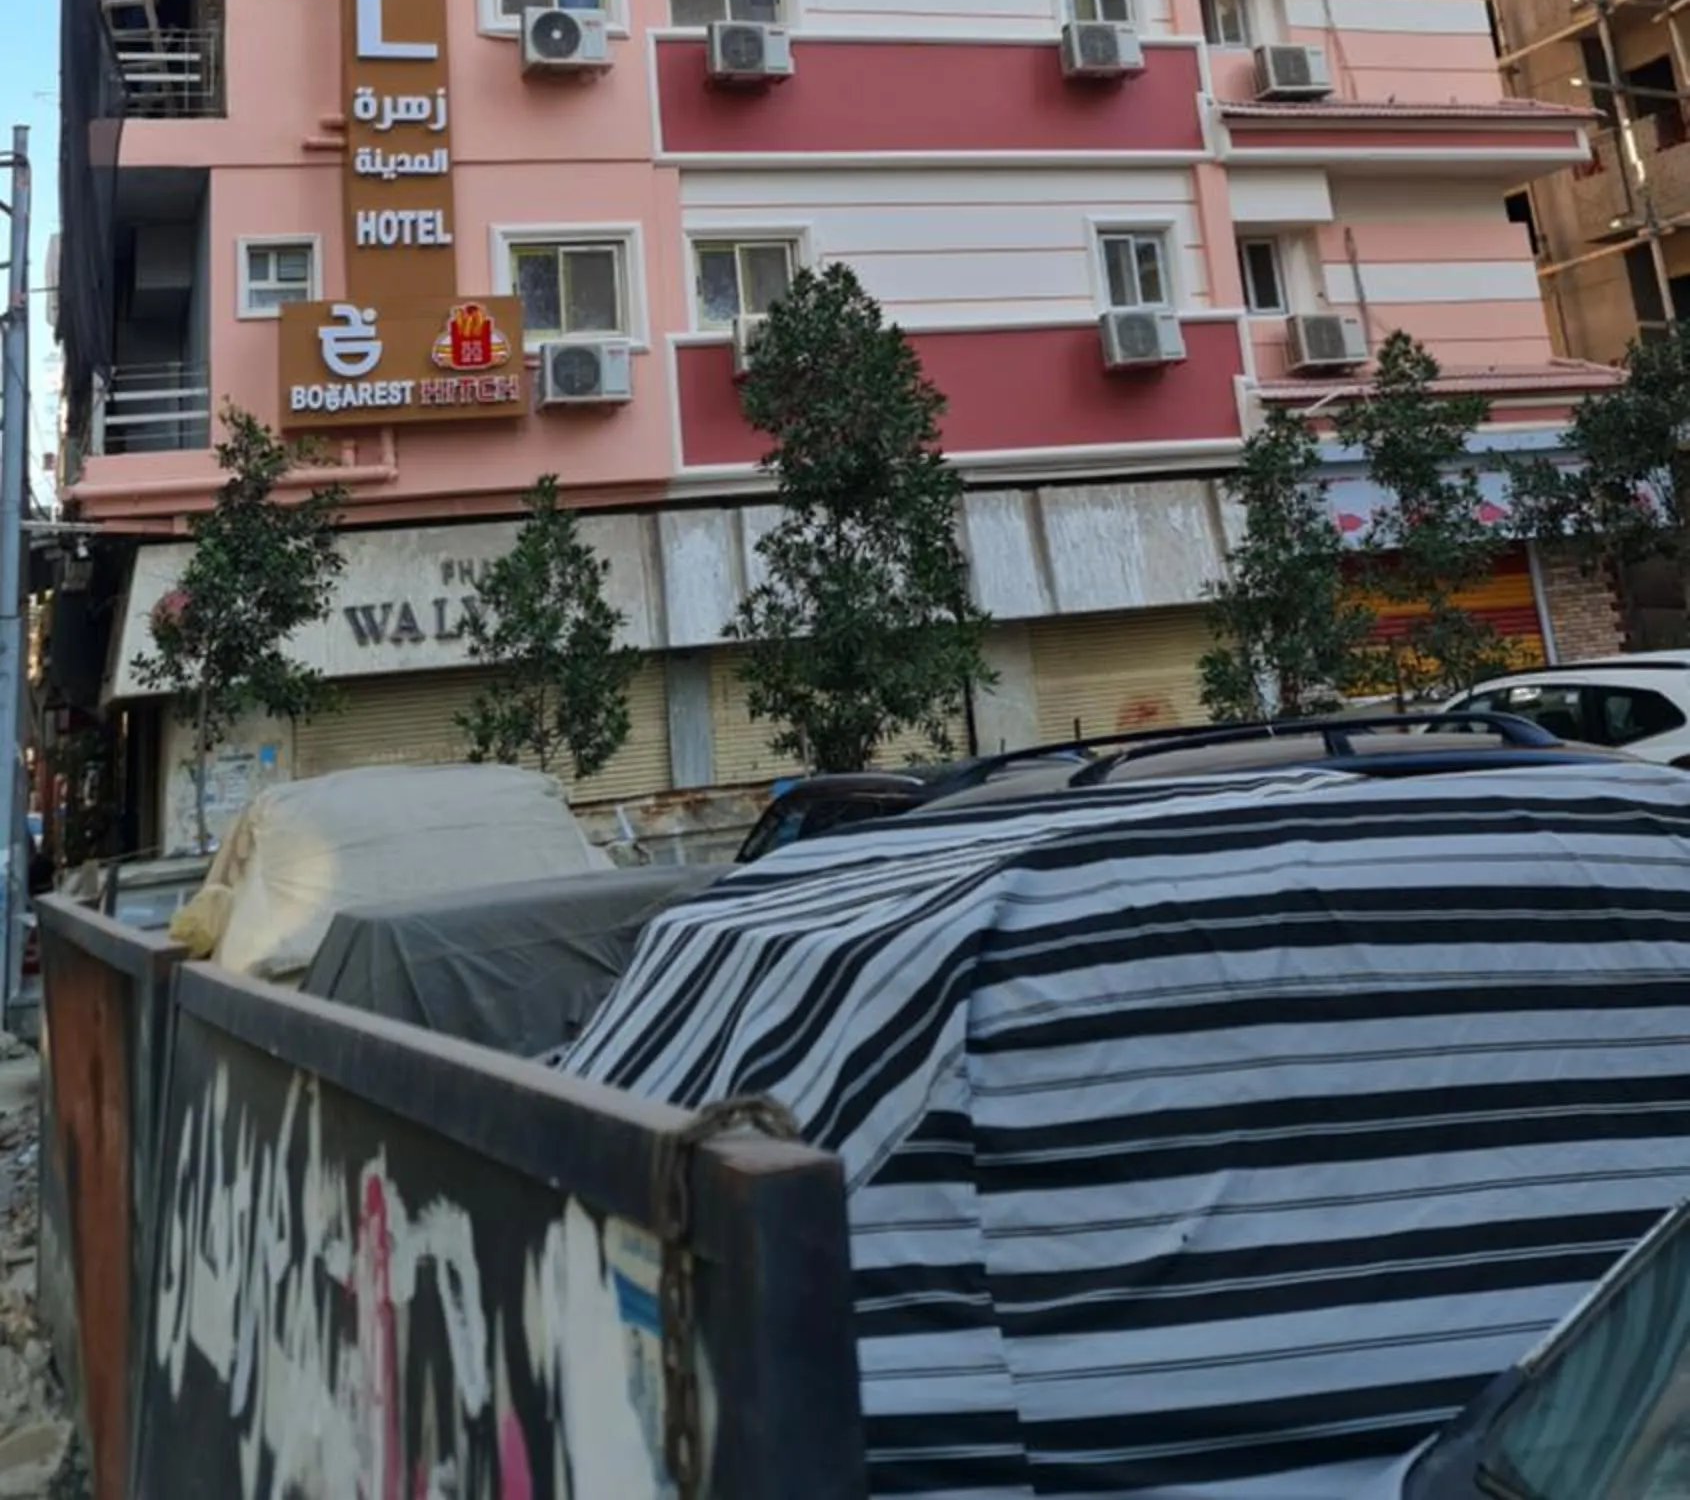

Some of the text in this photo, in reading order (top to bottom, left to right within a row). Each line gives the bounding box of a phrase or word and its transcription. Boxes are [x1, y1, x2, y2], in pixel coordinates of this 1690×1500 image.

[354, 87, 447, 130] زهرة
[355, 148, 449, 179] المدينة
[356, 210, 452, 245] HOTEL
